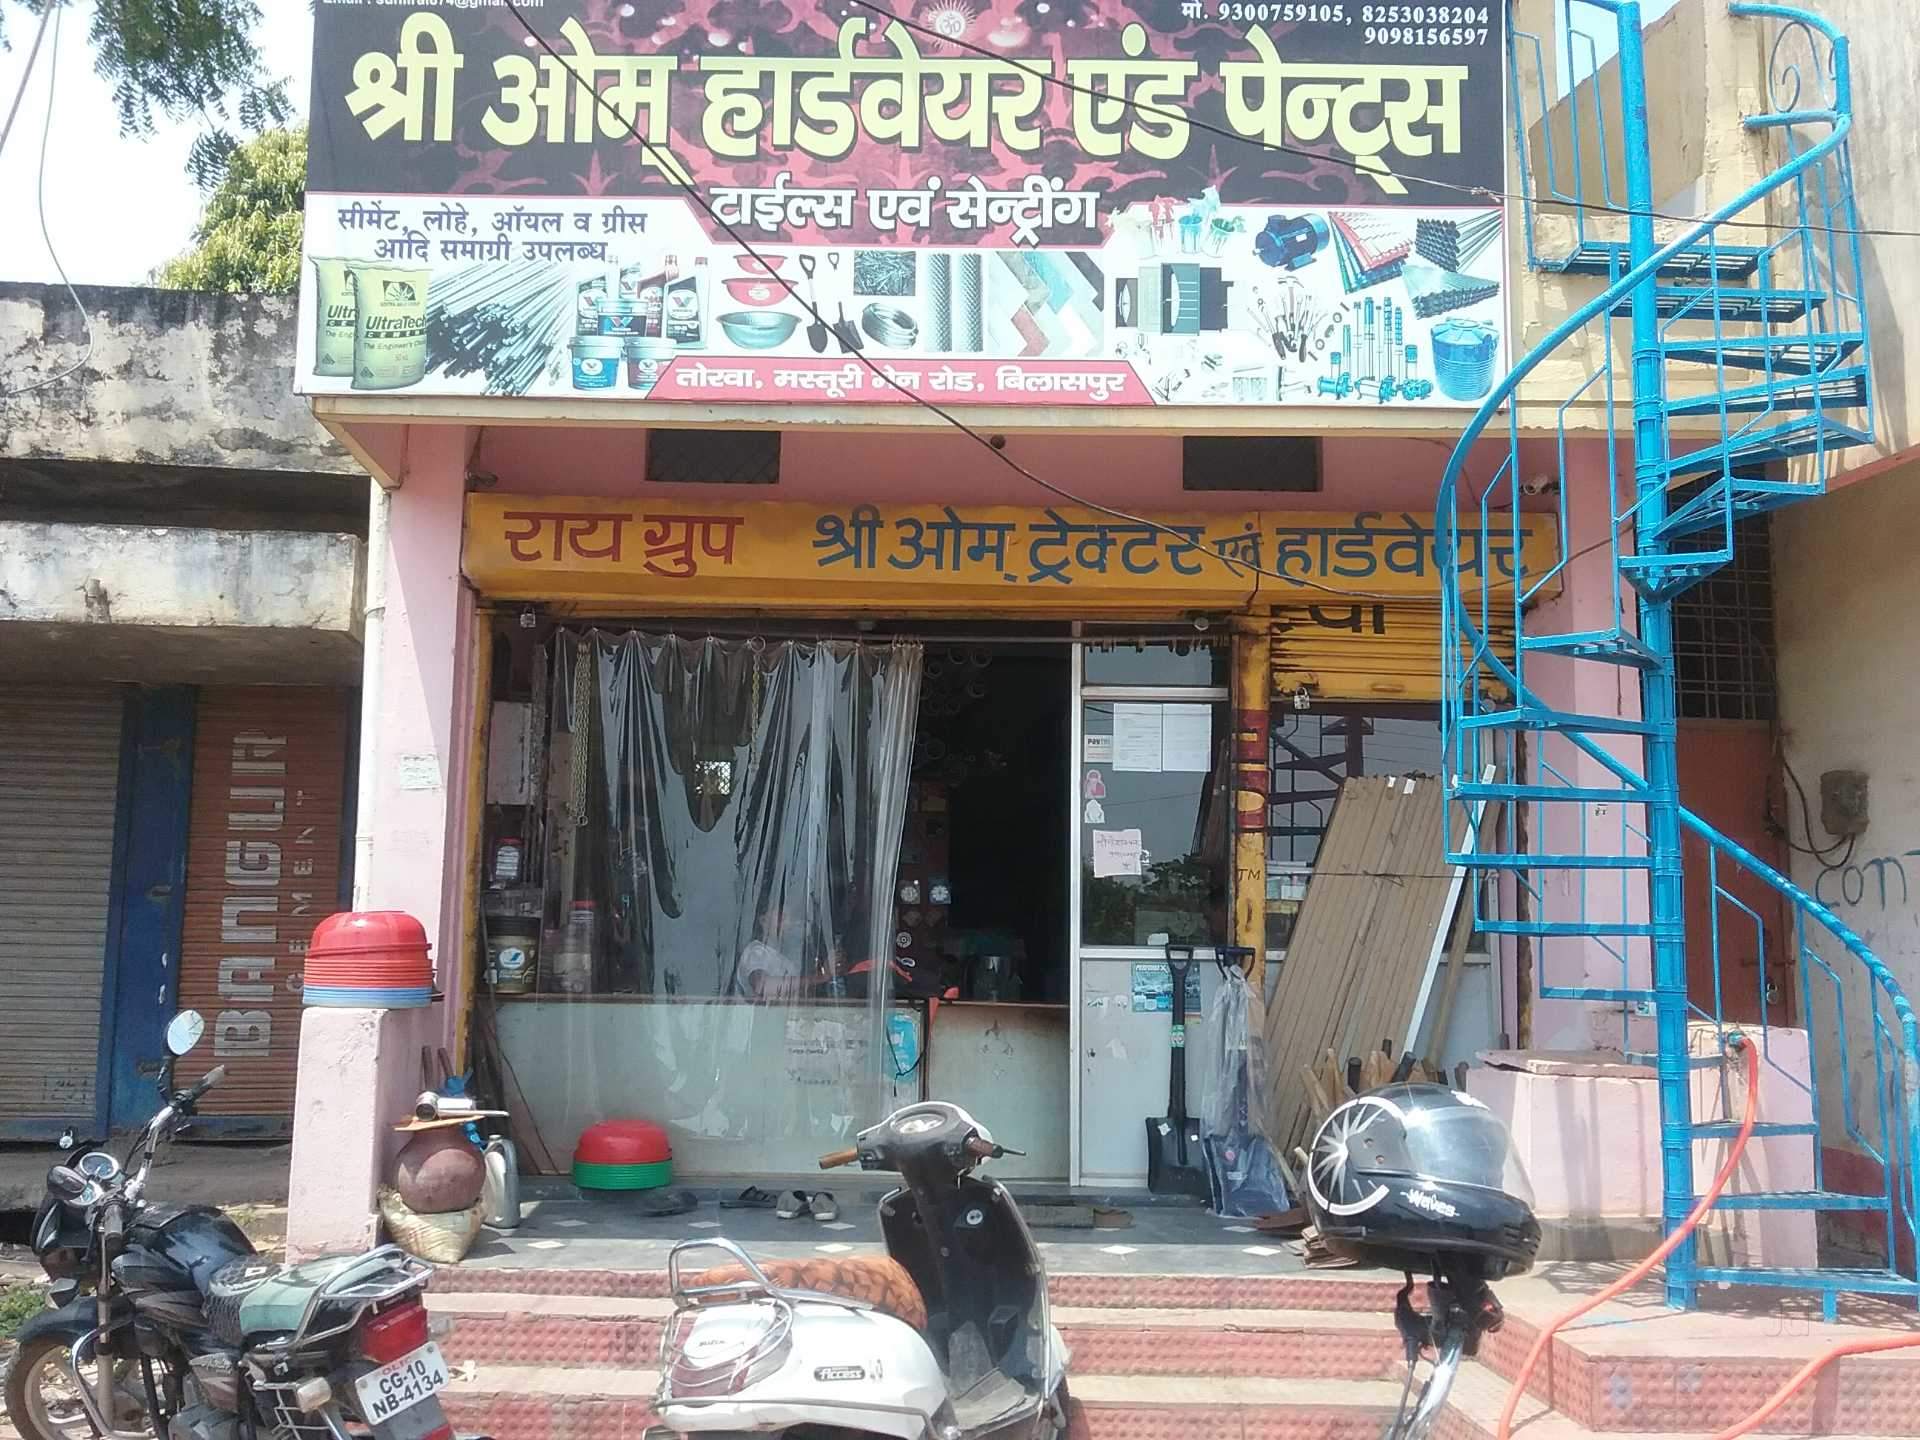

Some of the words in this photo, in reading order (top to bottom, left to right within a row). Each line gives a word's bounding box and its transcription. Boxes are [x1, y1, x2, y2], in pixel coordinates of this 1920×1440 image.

[1218, 4, 1353, 25] 9300759105,
[1361, 5, 1489, 25] 8253038204
[1363, 26, 1489, 46] 9098156597
[344, 11, 464, 143] श्री
[700, 17, 1054, 158] हार्डवेयर
[1067, 24, 1199, 162] एंड
[337, 201, 409, 234] सीमेंट,
[422, 203, 480, 237] लोहे,
[490, 205, 564, 234] ऑयल
[574, 212, 593, 233] व
[601, 204, 649, 235] ग्रीस
[710, 171, 857, 232] टाईल्स
[866, 175, 943, 230] एवं
[373, 230, 431, 263] आदि
[439, 232, 512, 264] समाग्री
[521, 241, 609, 263] उपलब्ध
[675, 362, 763, 390] तोरवा,
[773, 363, 864, 398] मस्तूरी
[871, 364, 922, 391] मेन
[928, 365, 985, 393] रोड,
[995, 364, 1127, 401] बिलासपुर
[504, 511, 632, 562] राय
[812, 504, 884, 570] श्री
[371, 1369, 444, 1419] NB-4134
[379, 1359, 426, 1395] CG-10
